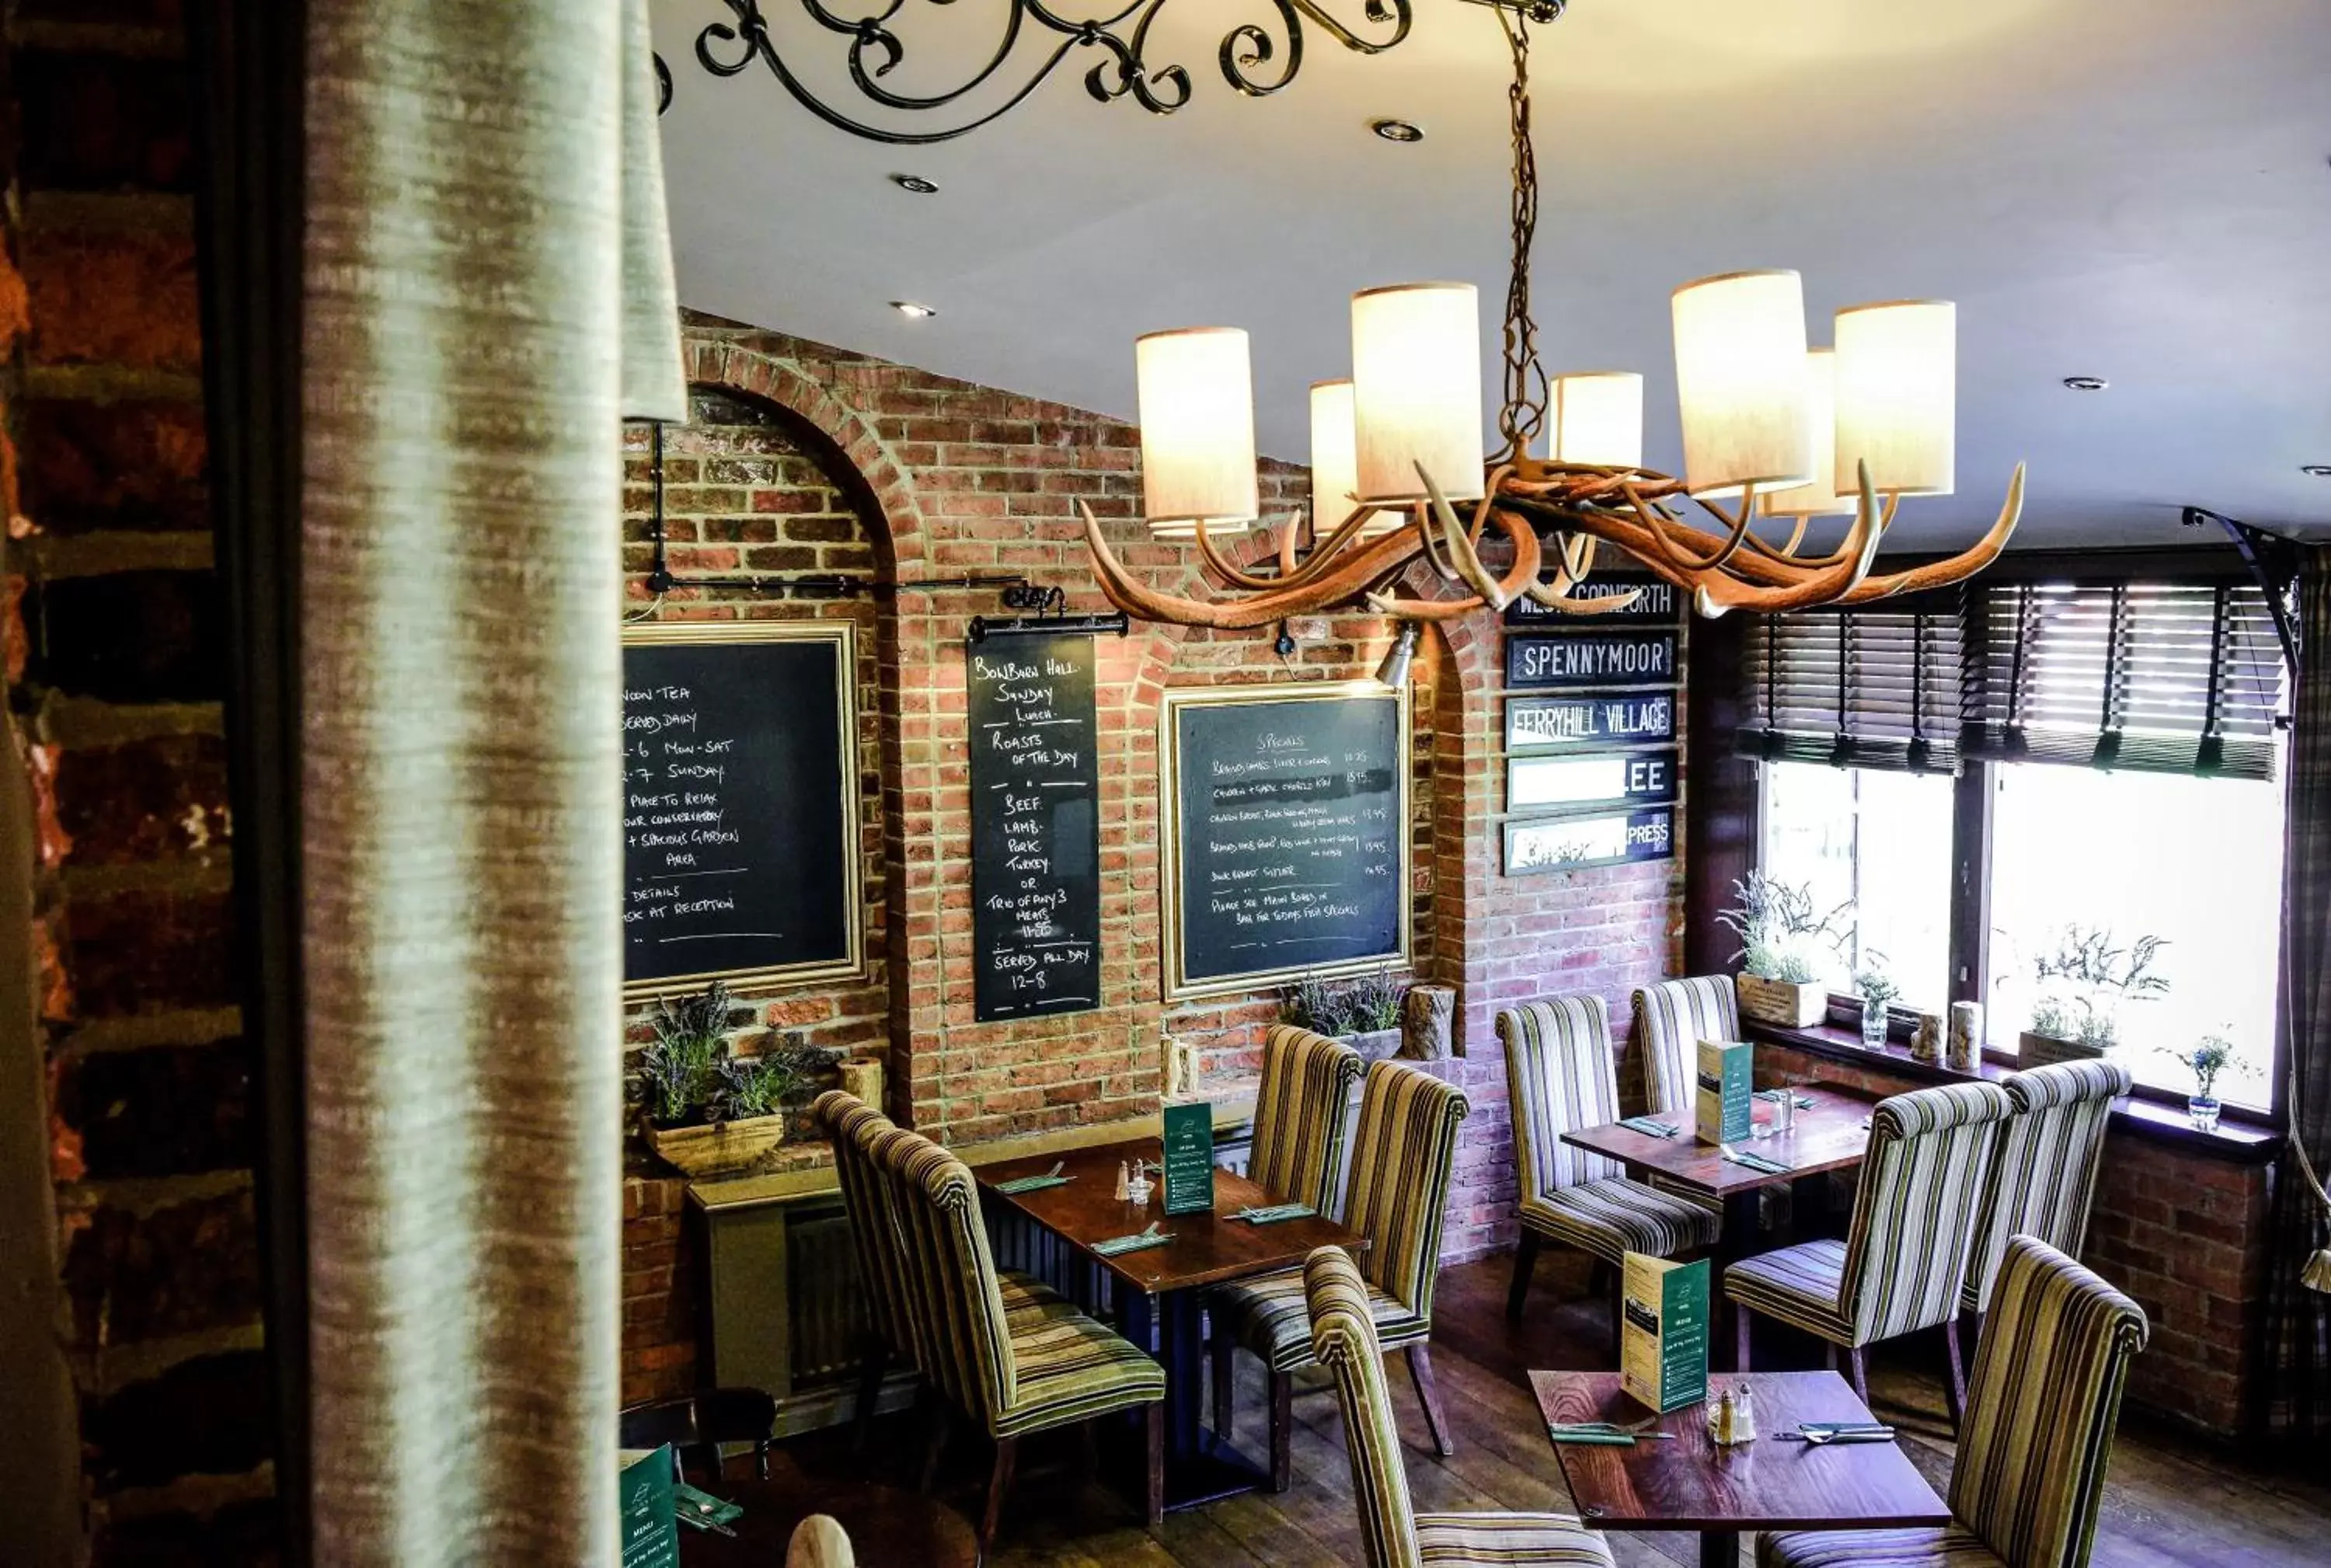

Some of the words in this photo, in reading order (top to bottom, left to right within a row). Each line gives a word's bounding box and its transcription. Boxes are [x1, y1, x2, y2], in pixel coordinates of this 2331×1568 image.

[1524, 643, 1664, 675] SPENNYMOOR
[662, 709, 697, 733] DAILY
[1605, 702, 1667, 733] VILLAGE
[992, 730, 1042, 750] ROASTS
[1026, 751, 1050, 764] THE
[1053, 749, 1078, 768] DAY
[668, 764, 725, 784] SUNDAY
[1624, 761, 1665, 793] EE
[1628, 824, 1670, 845] PRESS
[632, 885, 681, 901] DETAILS
[1057, 888, 1068, 904] 3
[674, 897, 735, 915] RECEPTION
[994, 953, 1037, 972] SERVED
[1011, 970, 1047, 991] 12-8
